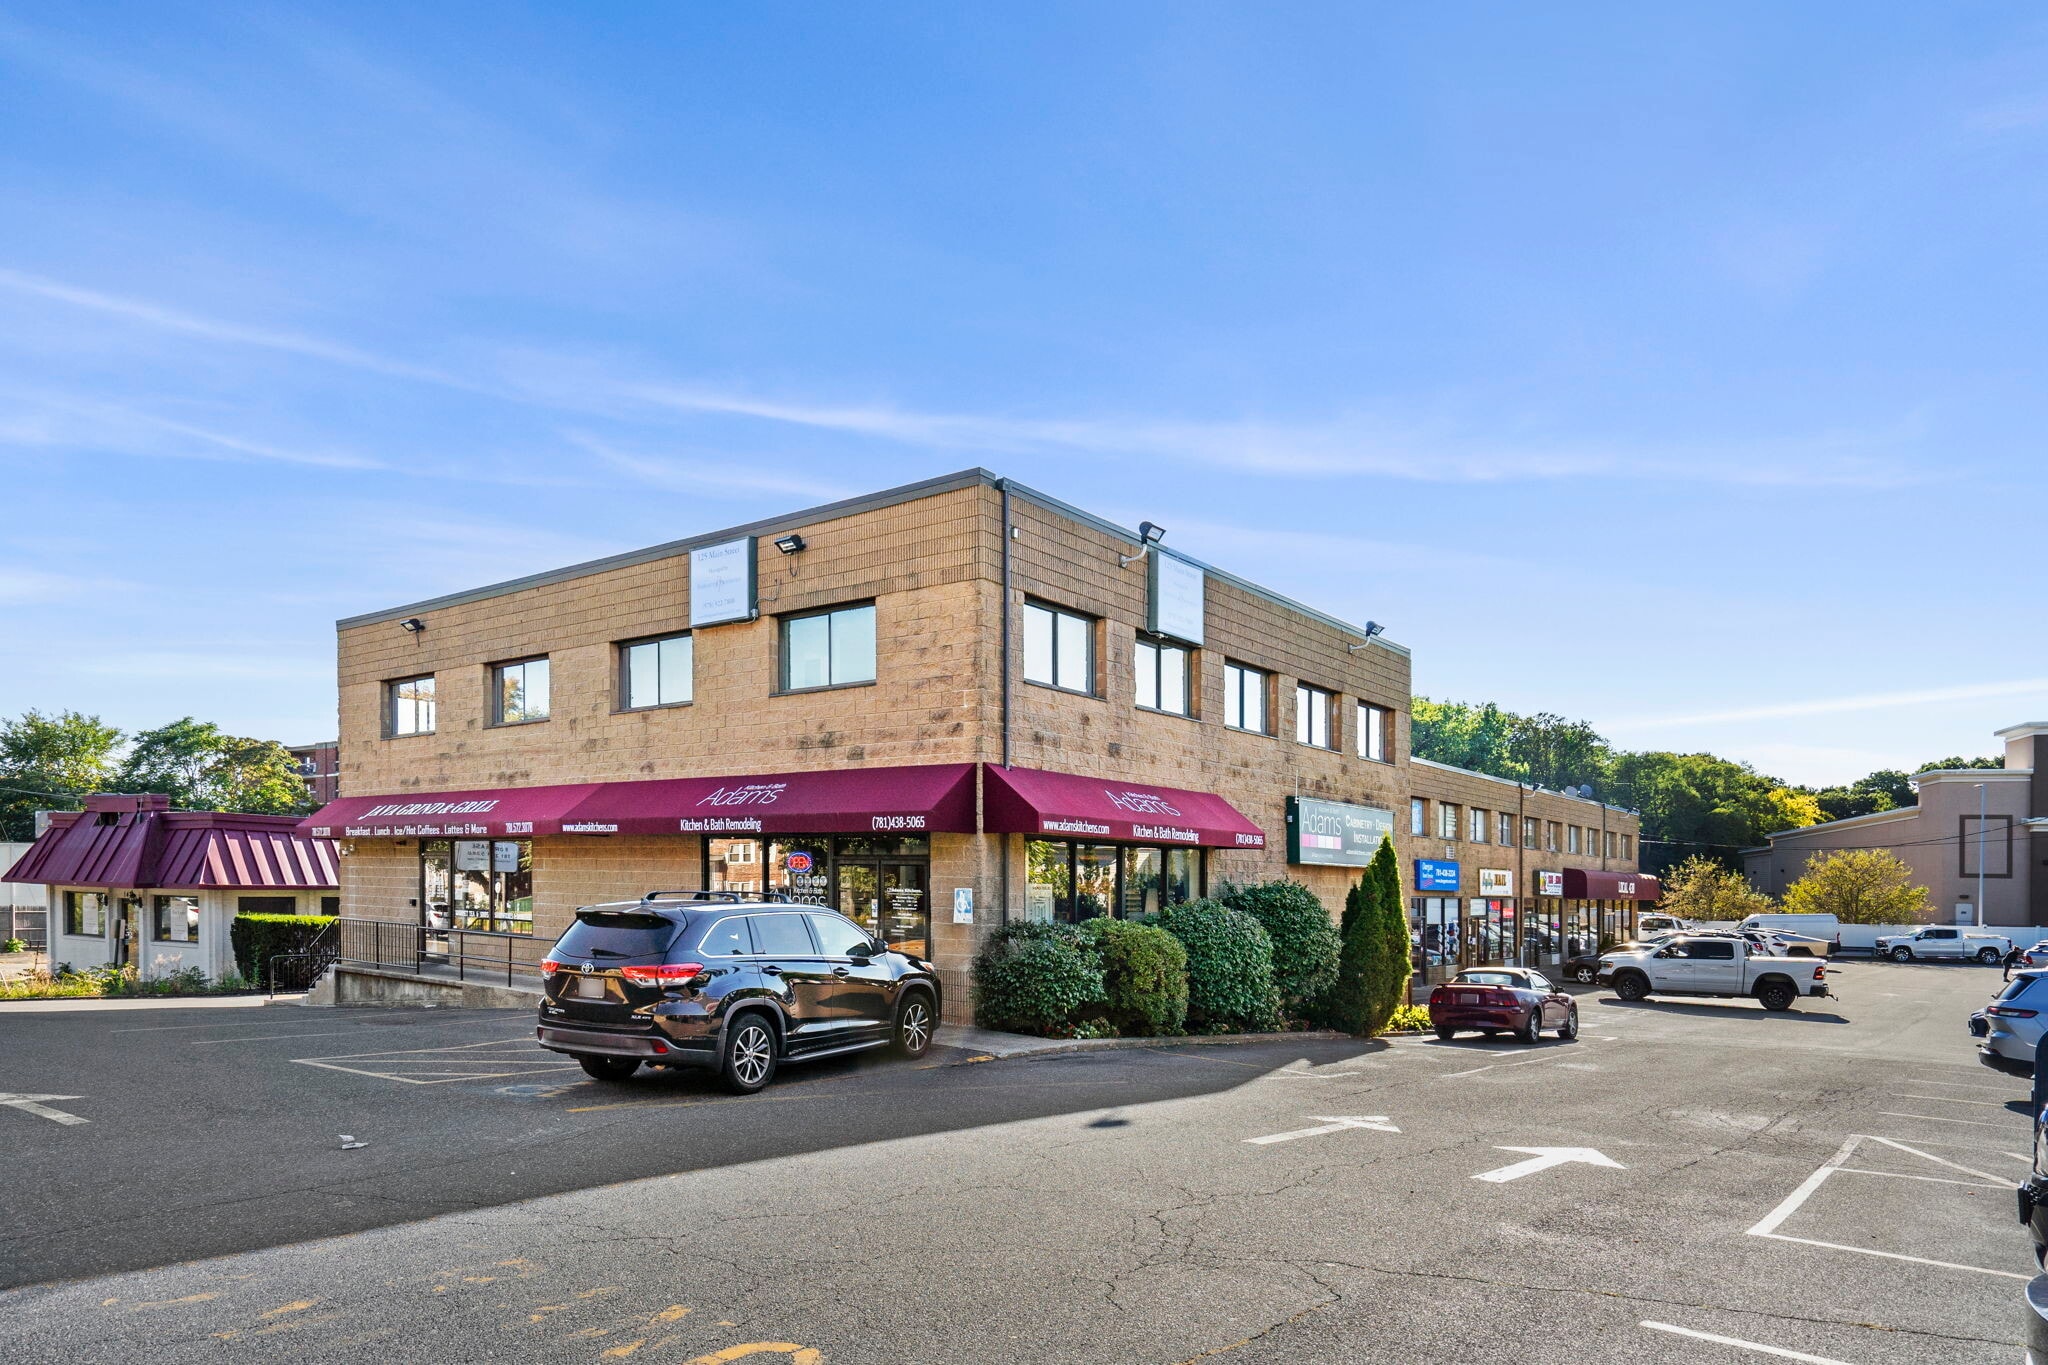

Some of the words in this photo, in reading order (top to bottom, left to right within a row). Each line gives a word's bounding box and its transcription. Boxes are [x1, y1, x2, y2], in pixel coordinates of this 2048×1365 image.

[708, 550, 723, 560] Main
[696, 786, 784, 806] Adams
[1104, 789, 1181, 817] Adams
[357, 804, 402, 820] JAVA
[396, 802, 446, 815] GRIND
[450, 800, 500, 813] GRILL
[345, 826, 370, 836] Breakfast
[374, 826, 391, 836] Lunch
[394, 825, 416, 835] Ice/Hot
[417, 824, 440, 835] Coffees
[444, 824, 463, 834] Lattes
[464, 823, 470, 834] &
[471, 823, 487, 834] More
[680, 819, 703, 831] Kitchen
[704, 818, 710, 831] &
[710, 818, 725, 831] Bath
[726, 817, 761, 832] Remodeling
[872, 815, 925, 830] (781)438-5065
[1043, 818, 1110, 834] www.adamskitchens.com
[1301, 805, 1342, 836] Adams
[1133, 824, 1153, 838] Kitchen
[1154, 827, 1159, 839] &
[1159, 826, 1171, 840] Bath
[1172, 827, 1199, 844] Remodeling
